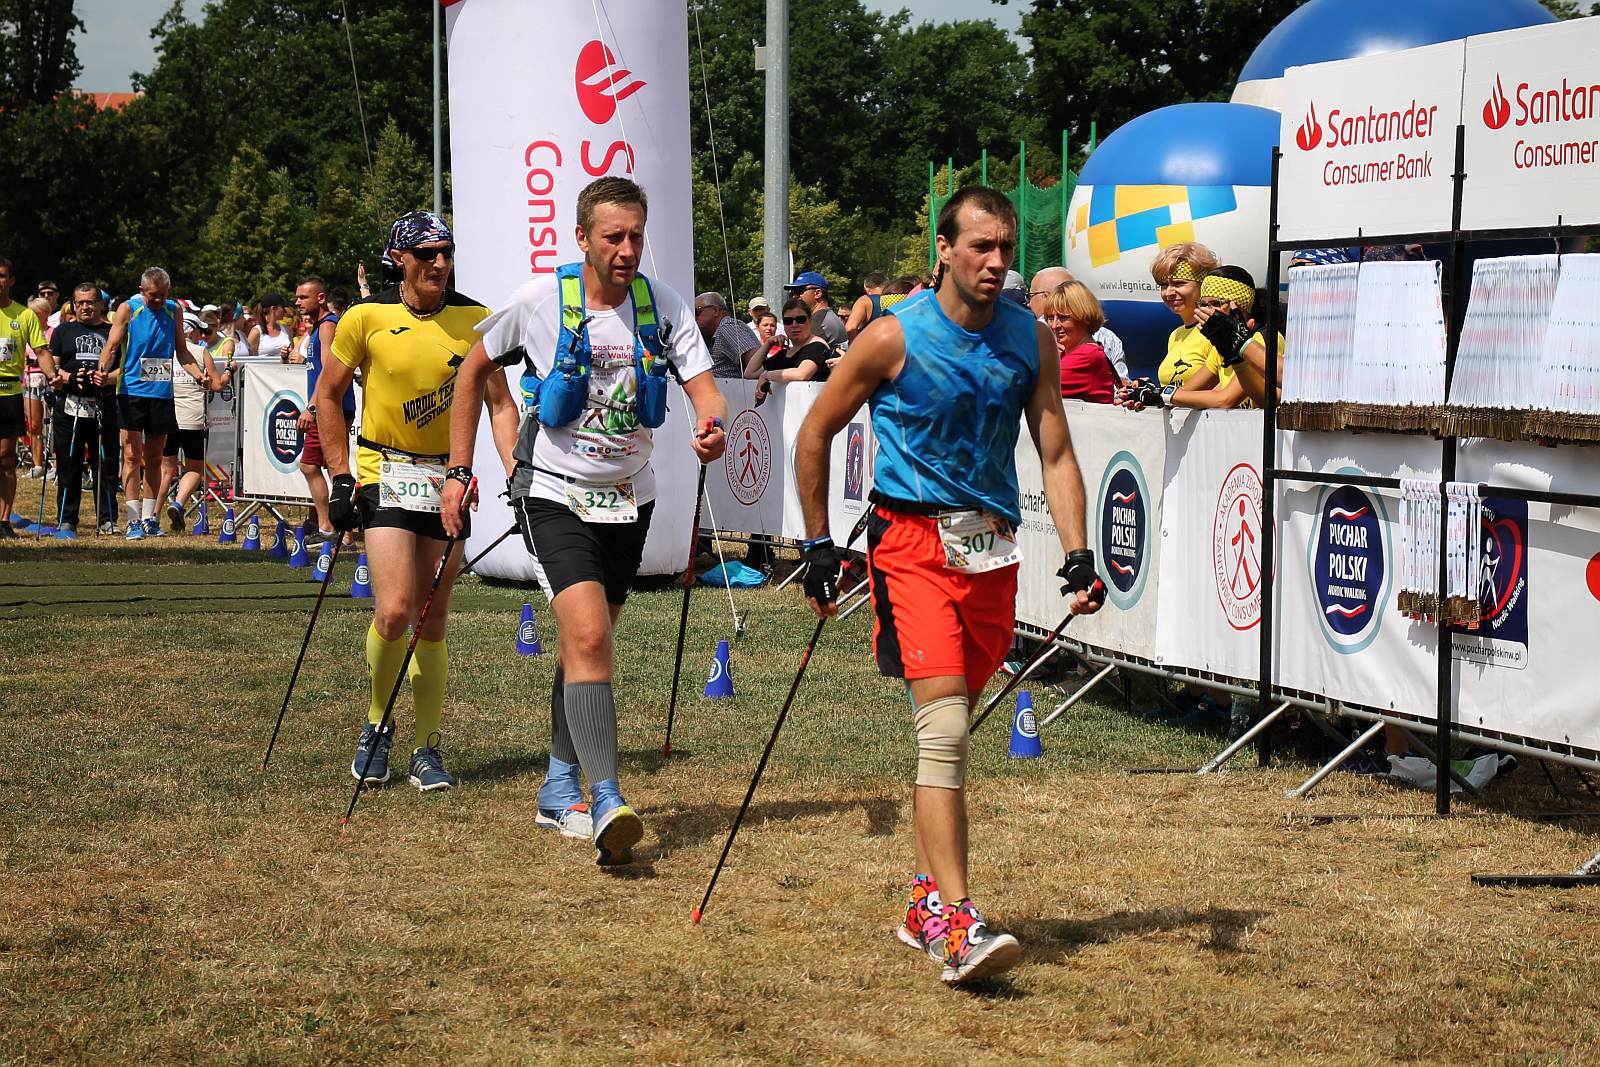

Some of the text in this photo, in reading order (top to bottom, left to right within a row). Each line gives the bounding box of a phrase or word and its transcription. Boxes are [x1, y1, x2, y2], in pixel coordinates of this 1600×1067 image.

[1326, 99, 1437, 148] Santander
[1514, 140, 1598, 169] Consumer
[1323, 150, 1432, 186] Consumer Bank
[525, 140, 562, 273] Consu
[148, 367, 163, 375] 291
[403, 391, 437, 424] NORDIC
[276, 429, 297, 440] POLSKI
[397, 481, 430, 498] 301
[584, 491, 619, 509] 322
[1112, 506, 1137, 527] PUCHAR
[961, 531, 995, 555] 307
[1111, 525, 1137, 548] POLSKI
[1329, 523, 1368, 549] PUCHAR
[1329, 553, 1368, 582] POLSKI
[1231, 589, 1262, 620] CONSUME
[1327, 584, 1367, 600] NORDIC WALKING
[1492, 577, 1525, 630] Nordic Walking
